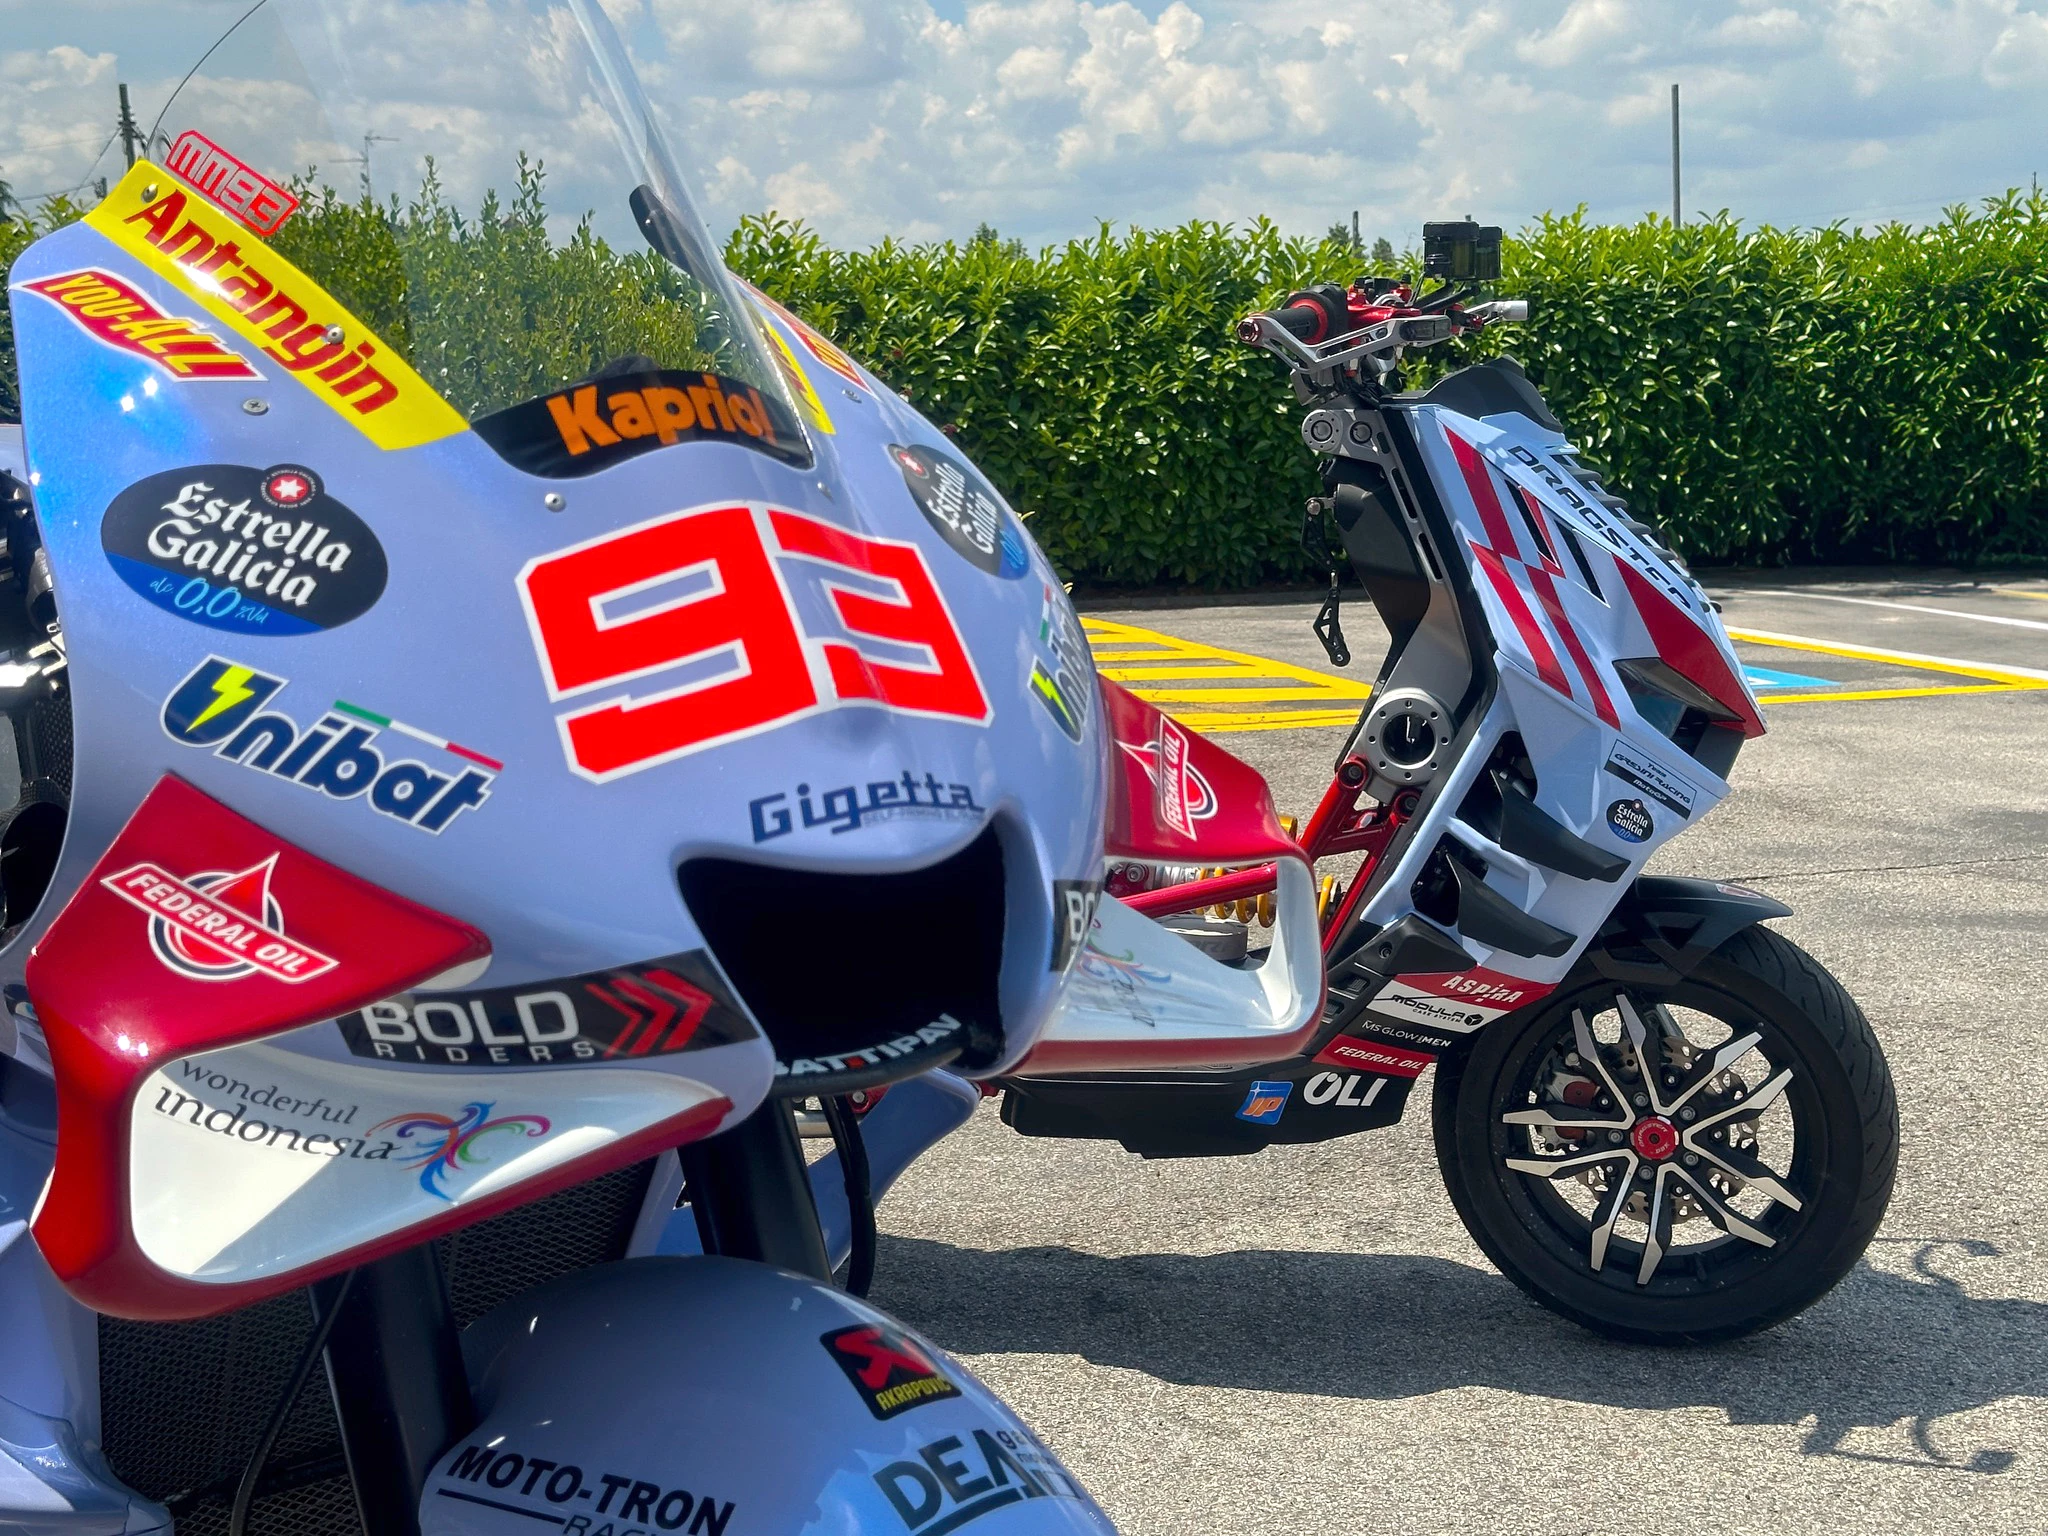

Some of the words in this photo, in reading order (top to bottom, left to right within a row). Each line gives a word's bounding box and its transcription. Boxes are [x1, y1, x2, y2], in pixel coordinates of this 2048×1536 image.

[167, 134, 295, 234] MM93
[123, 189, 399, 415] Antangin
[546, 374, 777, 456] Kapriol
[147, 518, 319, 607] Galicia
[160, 481, 352, 574] Estrella
[1506, 445, 1692, 609] DRAGSTER
[174, 577, 242, 618] 0,0
[515, 500, 994, 784] 93
[160, 654, 496, 836] Unibat
[749, 769, 986, 844] Gigetta
[1614, 813, 1643, 836] Galicia
[1616, 803, 1649, 828] Estrella
[125, 873, 258, 950] FEDERAL
[255, 943, 310, 974] OIL
[361, 991, 580, 1045] BOLD
[372, 1040, 596, 1063] RIDERS
[1381, 1027, 1419, 1041] GLOW
[182, 1059, 360, 1125] wonderful
[1303, 1071, 1388, 1107] OLI
[1334, 1046, 1395, 1067] FEDERAL
[1399, 1057, 1424, 1070] OIL
[154, 1086, 402, 1160] indonesia
[446, 1445, 736, 1536] MOTO-TRON
